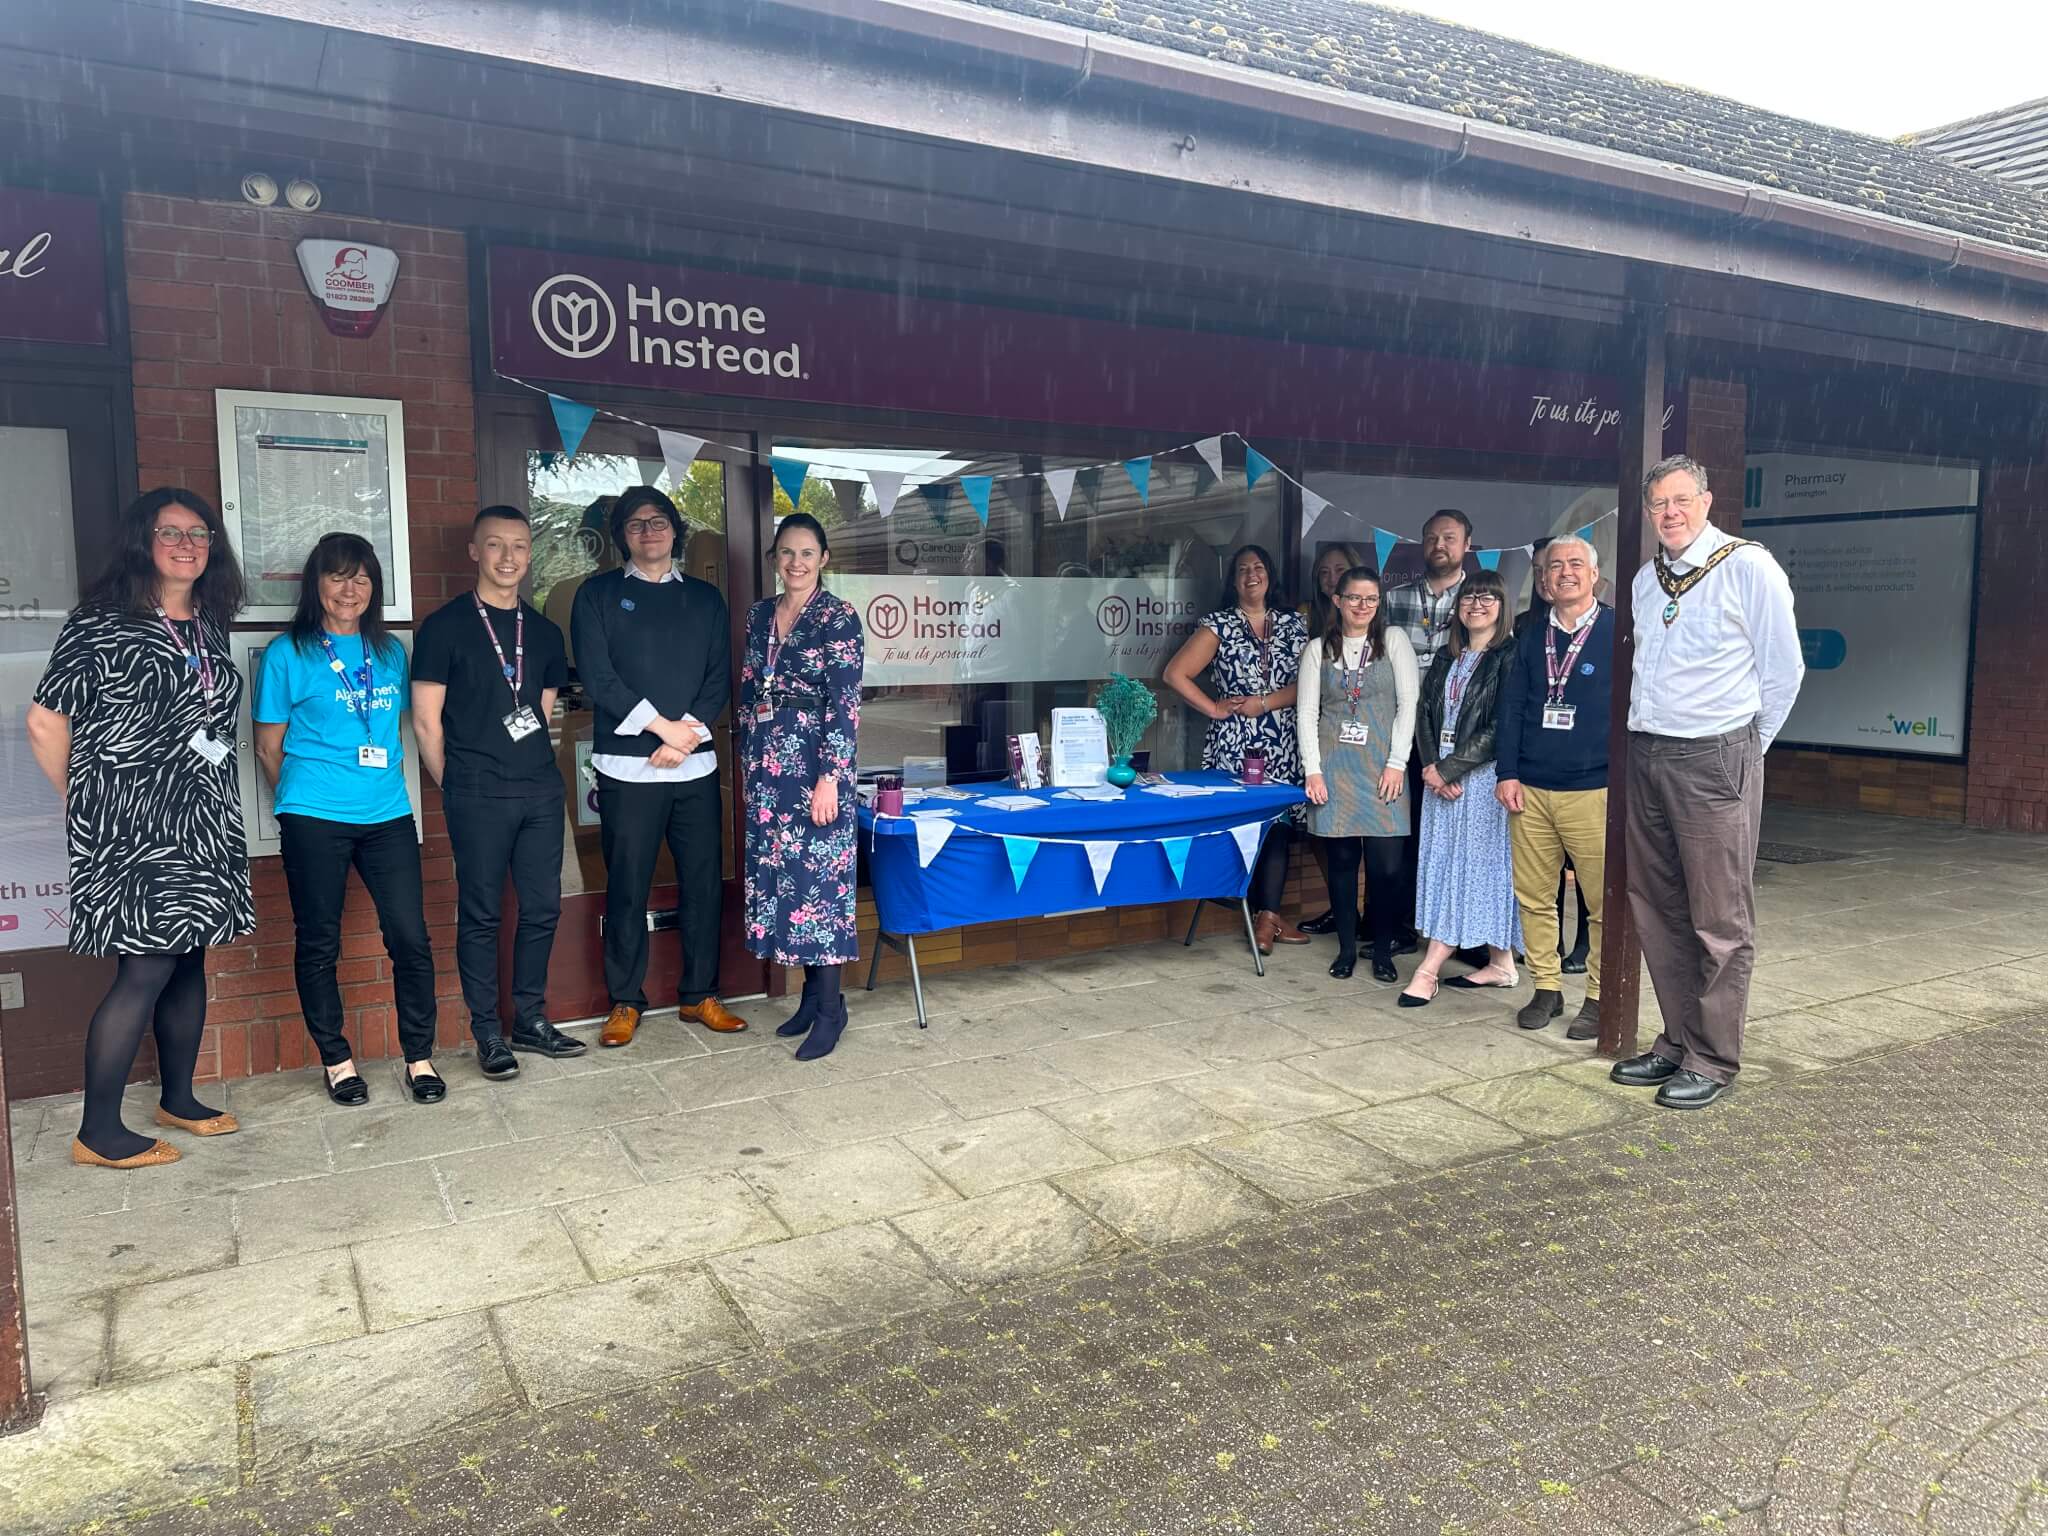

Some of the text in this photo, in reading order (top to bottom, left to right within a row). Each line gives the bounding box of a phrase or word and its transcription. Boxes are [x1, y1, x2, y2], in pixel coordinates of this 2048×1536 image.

[325, 278, 375, 290] COOMBER
[627, 283, 767, 334] Home
[1529, 396, 1551, 426] To
[1784, 473, 1847, 486] Pharmacy
[920, 543, 943, 553] Care
[913, 595, 984, 616] Home
[1136, 596, 1196, 616] Home
[913, 618, 1001, 638] Instead
[882, 647, 897, 664] To
[928, 645, 988, 666] personal
